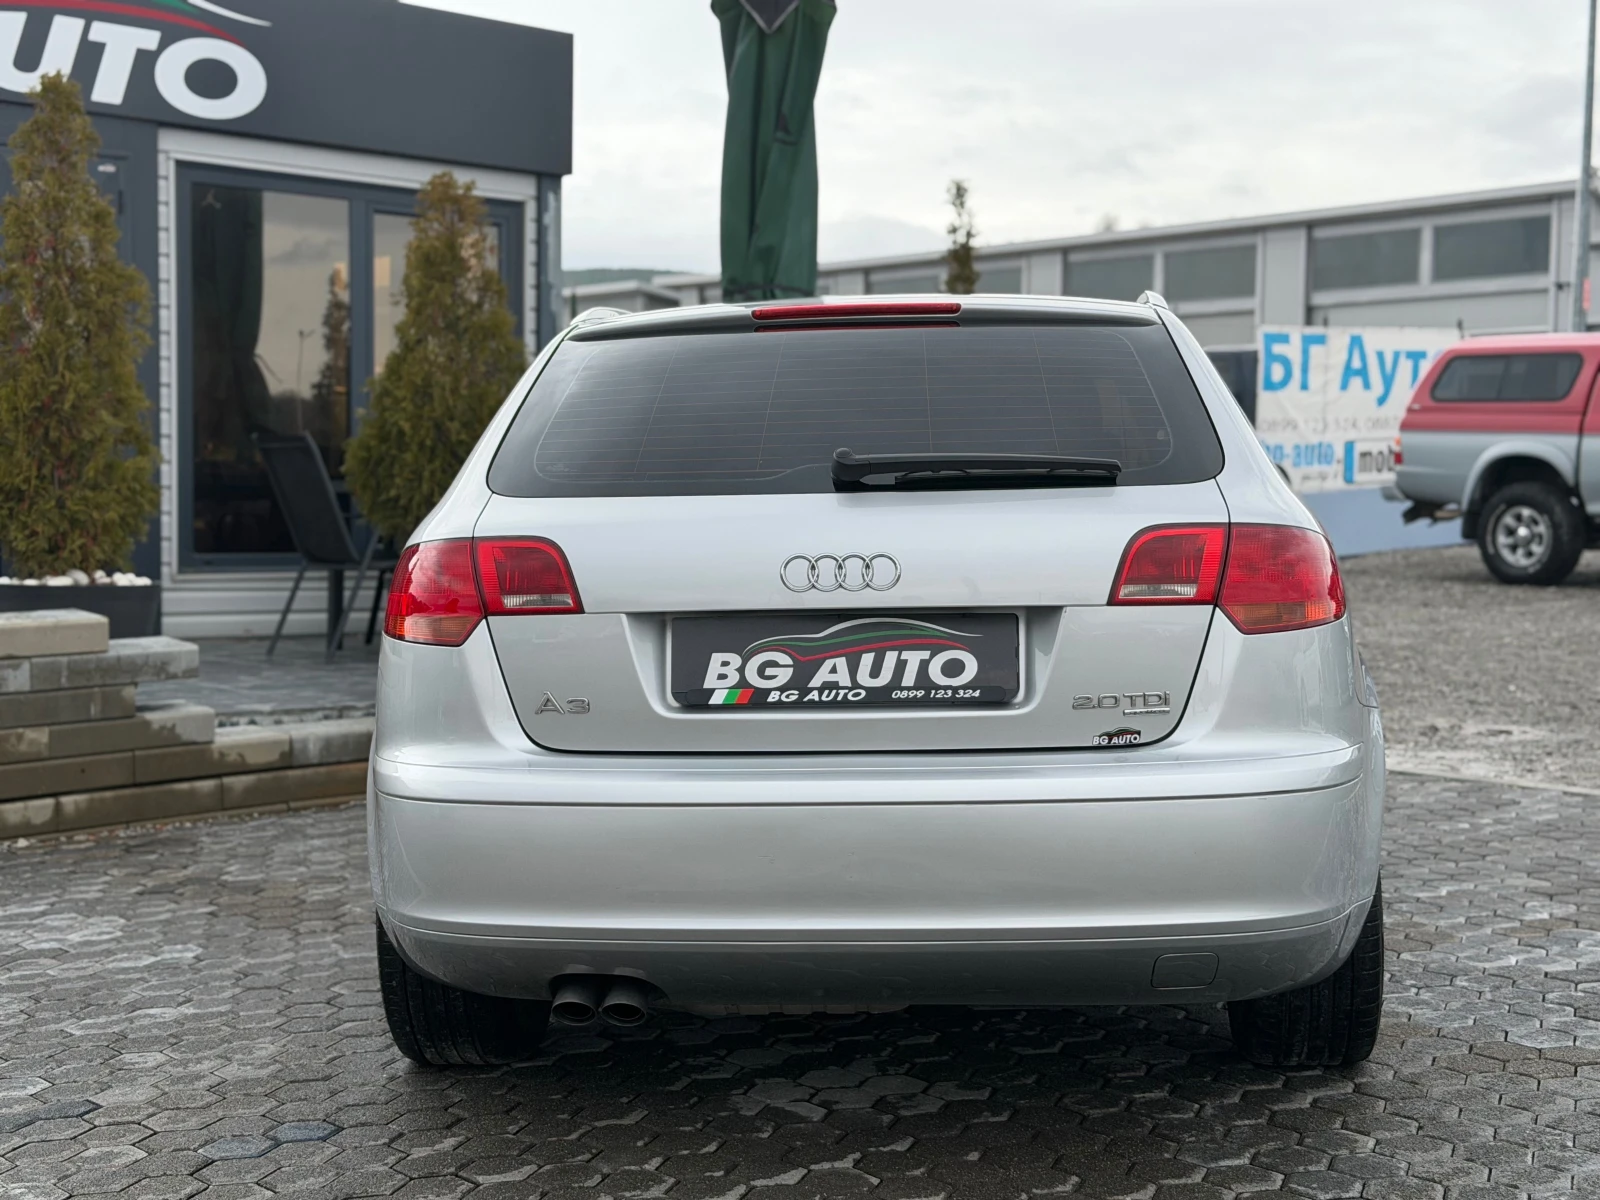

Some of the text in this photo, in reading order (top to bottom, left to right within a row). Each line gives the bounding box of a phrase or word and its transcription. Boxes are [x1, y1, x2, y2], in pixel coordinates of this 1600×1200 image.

[1262, 332, 1327, 391] БГ
[703, 649, 978, 688] BG AUTO
[534, 691, 591, 715] A3
[766, 689, 981, 702] BG AUTO 0899 123 324
[1072, 693, 1120, 710] 2.0
[1092, 734, 1140, 745] BG AUTO
